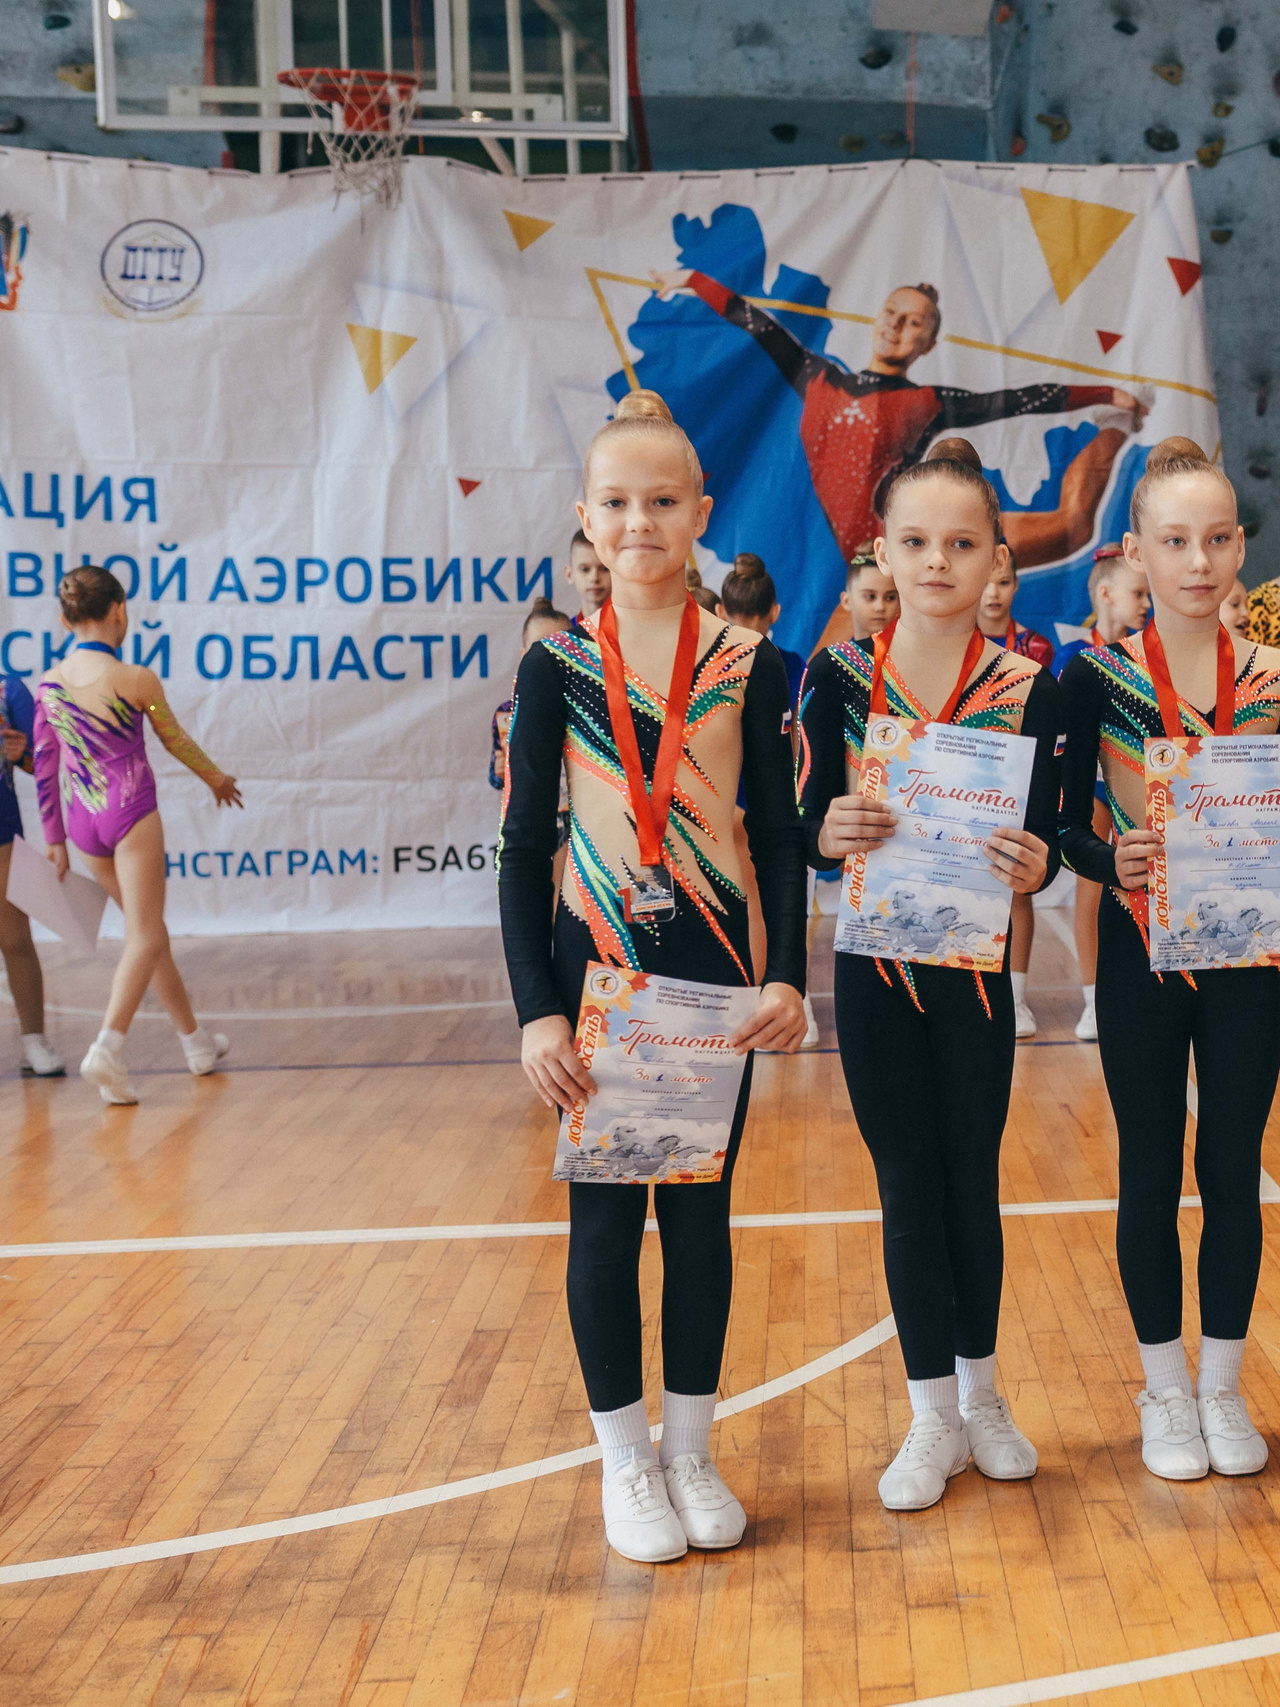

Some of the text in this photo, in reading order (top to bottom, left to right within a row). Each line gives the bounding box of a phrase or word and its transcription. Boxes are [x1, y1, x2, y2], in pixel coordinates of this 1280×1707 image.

[121, 246, 185, 281] ДГТУ
[208, 556, 554, 603] АЭРОБИКИ
[1, 620, 490, 681] СКЙ ОБЛАСТИ
[898, 768, 1018, 809] Грамота
[910, 823, 928, 838] За
[935, 830, 943, 840] 1
[1204, 834, 1278, 848] За 1 место
[165, 848, 379, 878] НСТАГРАМ:
[849, 851, 868, 912] ДОНСК
[632, 1068, 713, 1083] За 1 место
[568, 1098, 586, 1148] ДОНС
